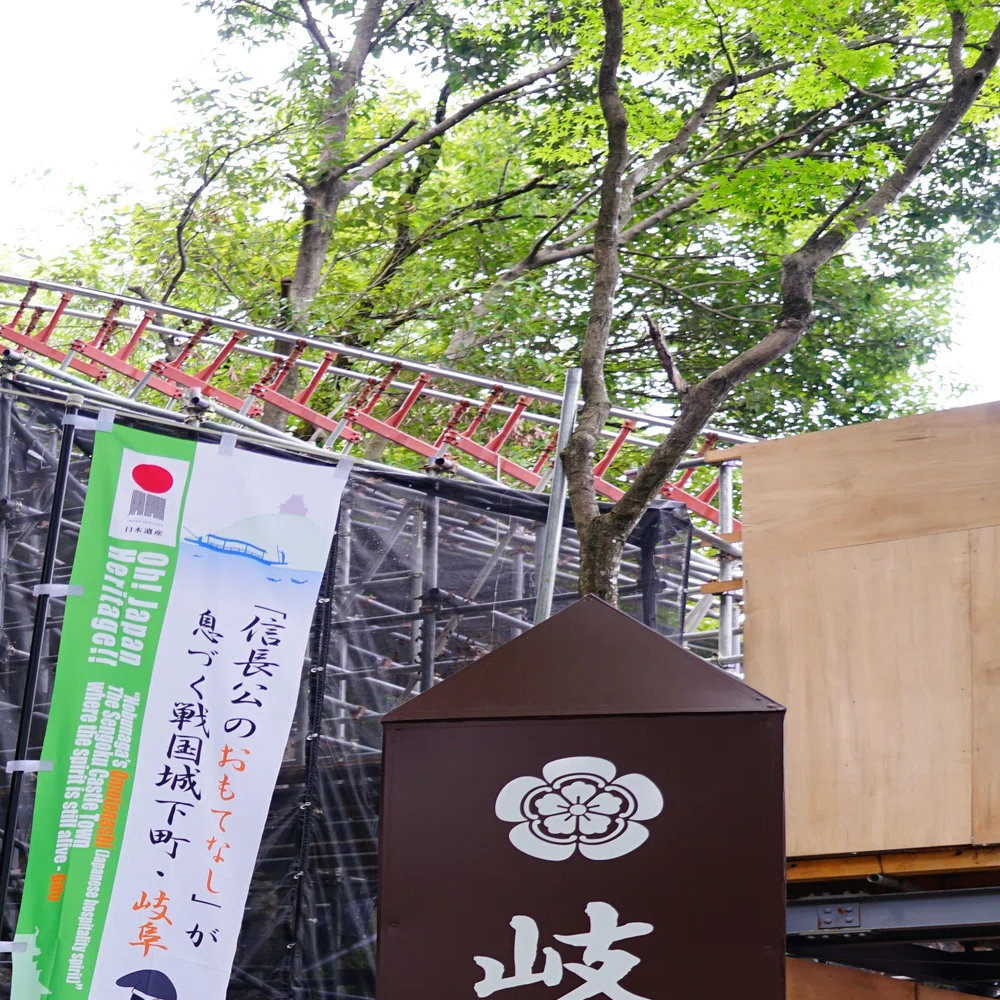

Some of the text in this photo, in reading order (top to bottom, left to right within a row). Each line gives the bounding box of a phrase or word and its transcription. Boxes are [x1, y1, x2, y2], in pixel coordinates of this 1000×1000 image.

[124, 526, 163, 536] 日本遺産
[131, 551, 169, 593] Oh!
[88, 545, 137, 667] Heritage!!
[119, 596, 158, 667] Japan
[80, 682, 105, 722] where
[74, 725, 97, 746] the
[67, 748, 89, 785] spirit
[72, 685, 124, 848] The Sengoku Castle Town
[185, 605, 286, 947] 「信長公のおもてなし」が
[64, 786, 84, 799] is
[94, 769, 129, 849] Omotenashi
[59, 801, 78, 828] still
[53, 830, 73, 864] alive
[71, 898, 99, 952] hospitality
